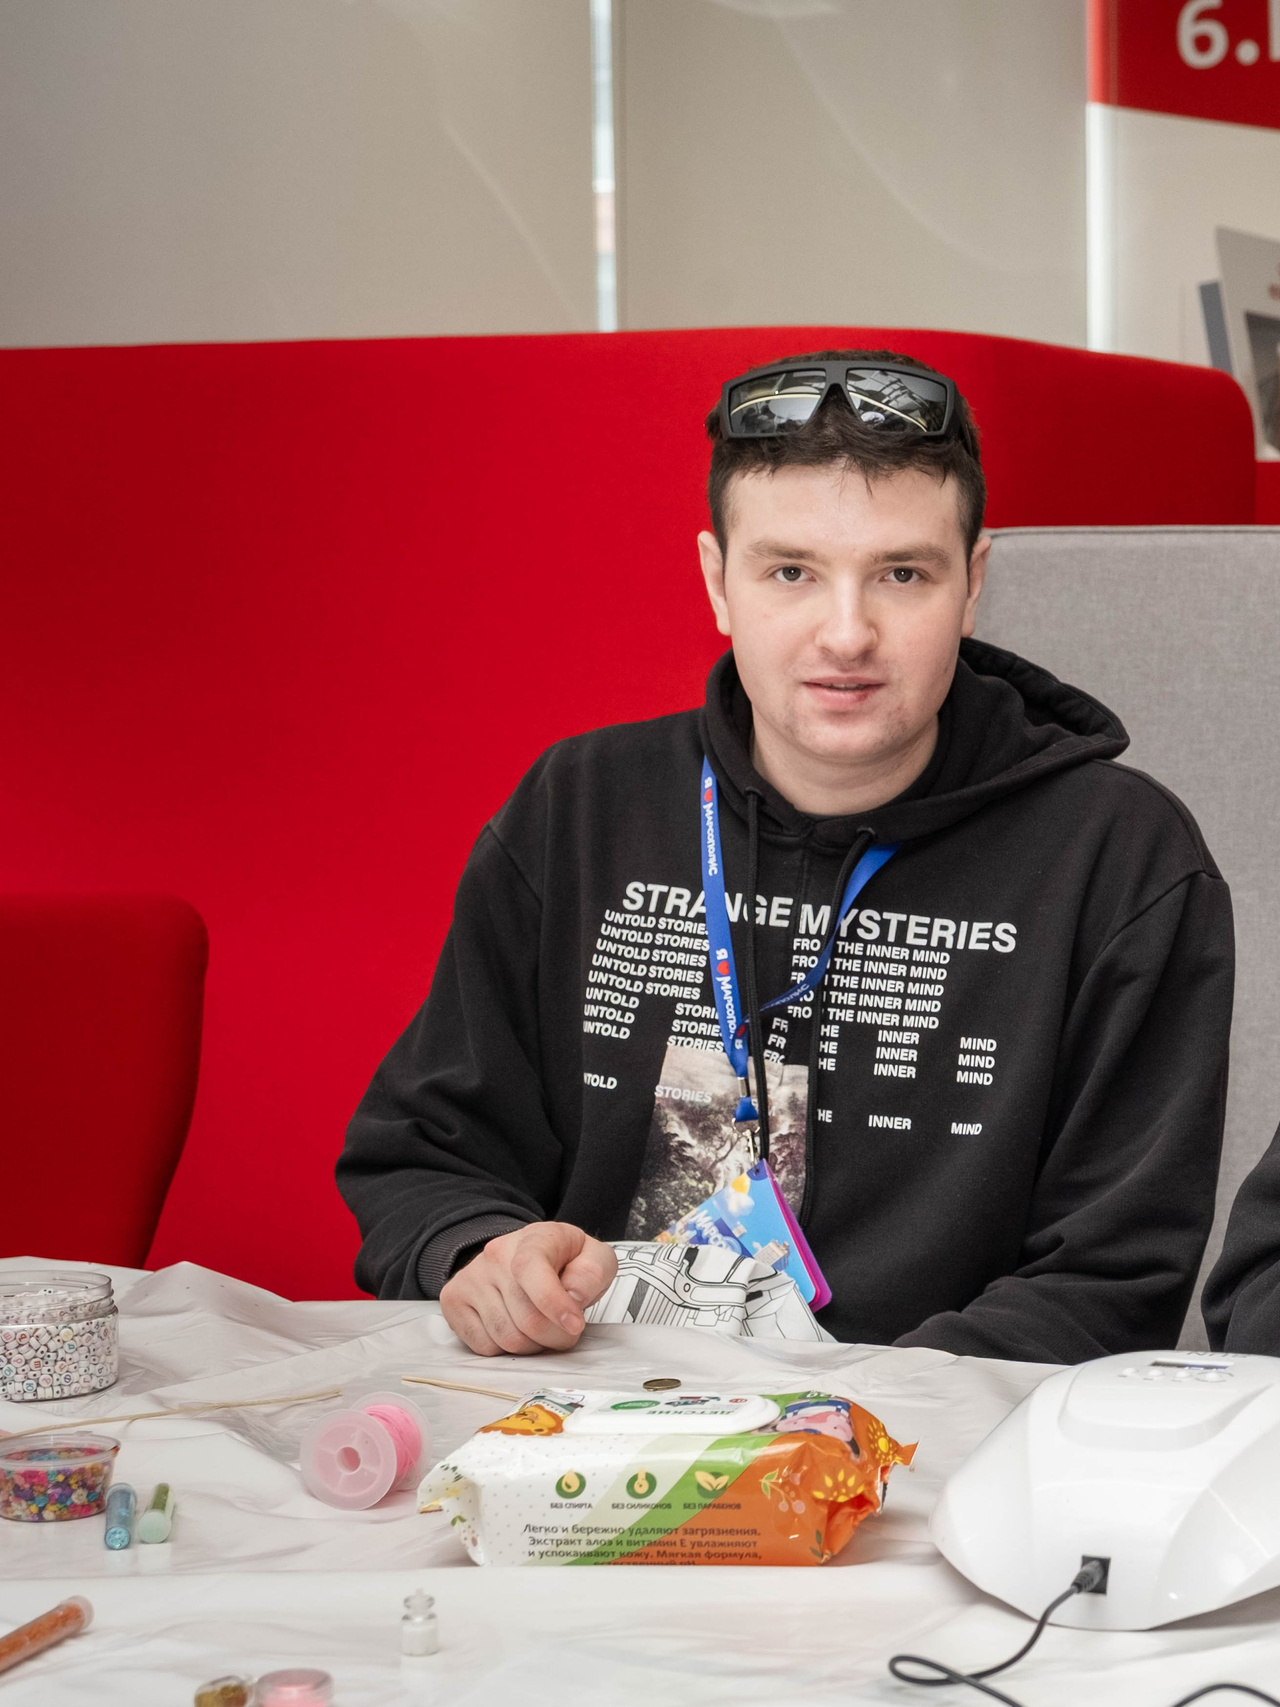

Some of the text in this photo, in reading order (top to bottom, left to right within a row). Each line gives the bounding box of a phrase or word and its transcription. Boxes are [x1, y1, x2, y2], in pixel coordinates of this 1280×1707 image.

[704, 777, 713, 788] Я
[600, 923, 947, 981] UNTOLD STORIES FRO THE INNER MIND
[604, 909, 950, 964] UNTOLD STORIE FRO THE INNER MIND
[798, 903, 1018, 953] MYSTERIES
[596, 938, 650, 960] UNTOLD
[652, 949, 707, 967] STORIES
[832, 974, 859, 988] THE
[861, 977, 905, 993] INNER
[907, 982, 944, 997] MIND
[715, 948, 728, 960] Я
[588, 970, 643, 993] UNTOLD
[645, 980, 701, 1000] STORIES
[828, 1008, 855, 1022] THE
[856, 1010, 900, 1026] INNER
[902, 1015, 939, 1029] MIND
[592, 954, 648, 977] UNTOLD
[648, 965, 704, 984] STORIES
[830, 991, 857, 1006] THE
[859, 994, 902, 1010] INNER
[905, 999, 941, 1013] MIND
[584, 1004, 995, 1069] UNTOLD STORIE FR HE INNER MIND
[585, 987, 640, 1009] UNTOLD
[675, 1002, 719, 1020] STORI
[820, 1024, 840, 1038] HE
[878, 1030, 920, 1044] INNER
[960, 1037, 997, 1052] MIND
[667, 1035, 725, 1053] STORIES
[818, 1058, 836, 1071] HE
[873, 1063, 916, 1079] INNER
[956, 1071, 993, 1086] MIND
[654, 1084, 713, 1103] STORIES
[817, 1109, 833, 1123] HE
[868, 1115, 911, 1130] INNER
[951, 1122, 983, 1135] MIND
[523, 1524, 558, 1534] Легко
[571, 1524, 625, 1536] бережно
[628, 1526, 679, 1536] удаляют
[682, 1527, 761, 1538] загрязнения.
[683, 1502, 696, 1510] БЕЗ
[528, 1536, 582, 1547] Экстракт
[585, 1538, 613, 1546] алоэ
[690, 1541, 758, 1550] увлажняют
[538, 1550, 616, 1559] успокаивают
[657, 1550, 702, 1559] Мягкая
[704, 1550, 763, 1560] формула,
